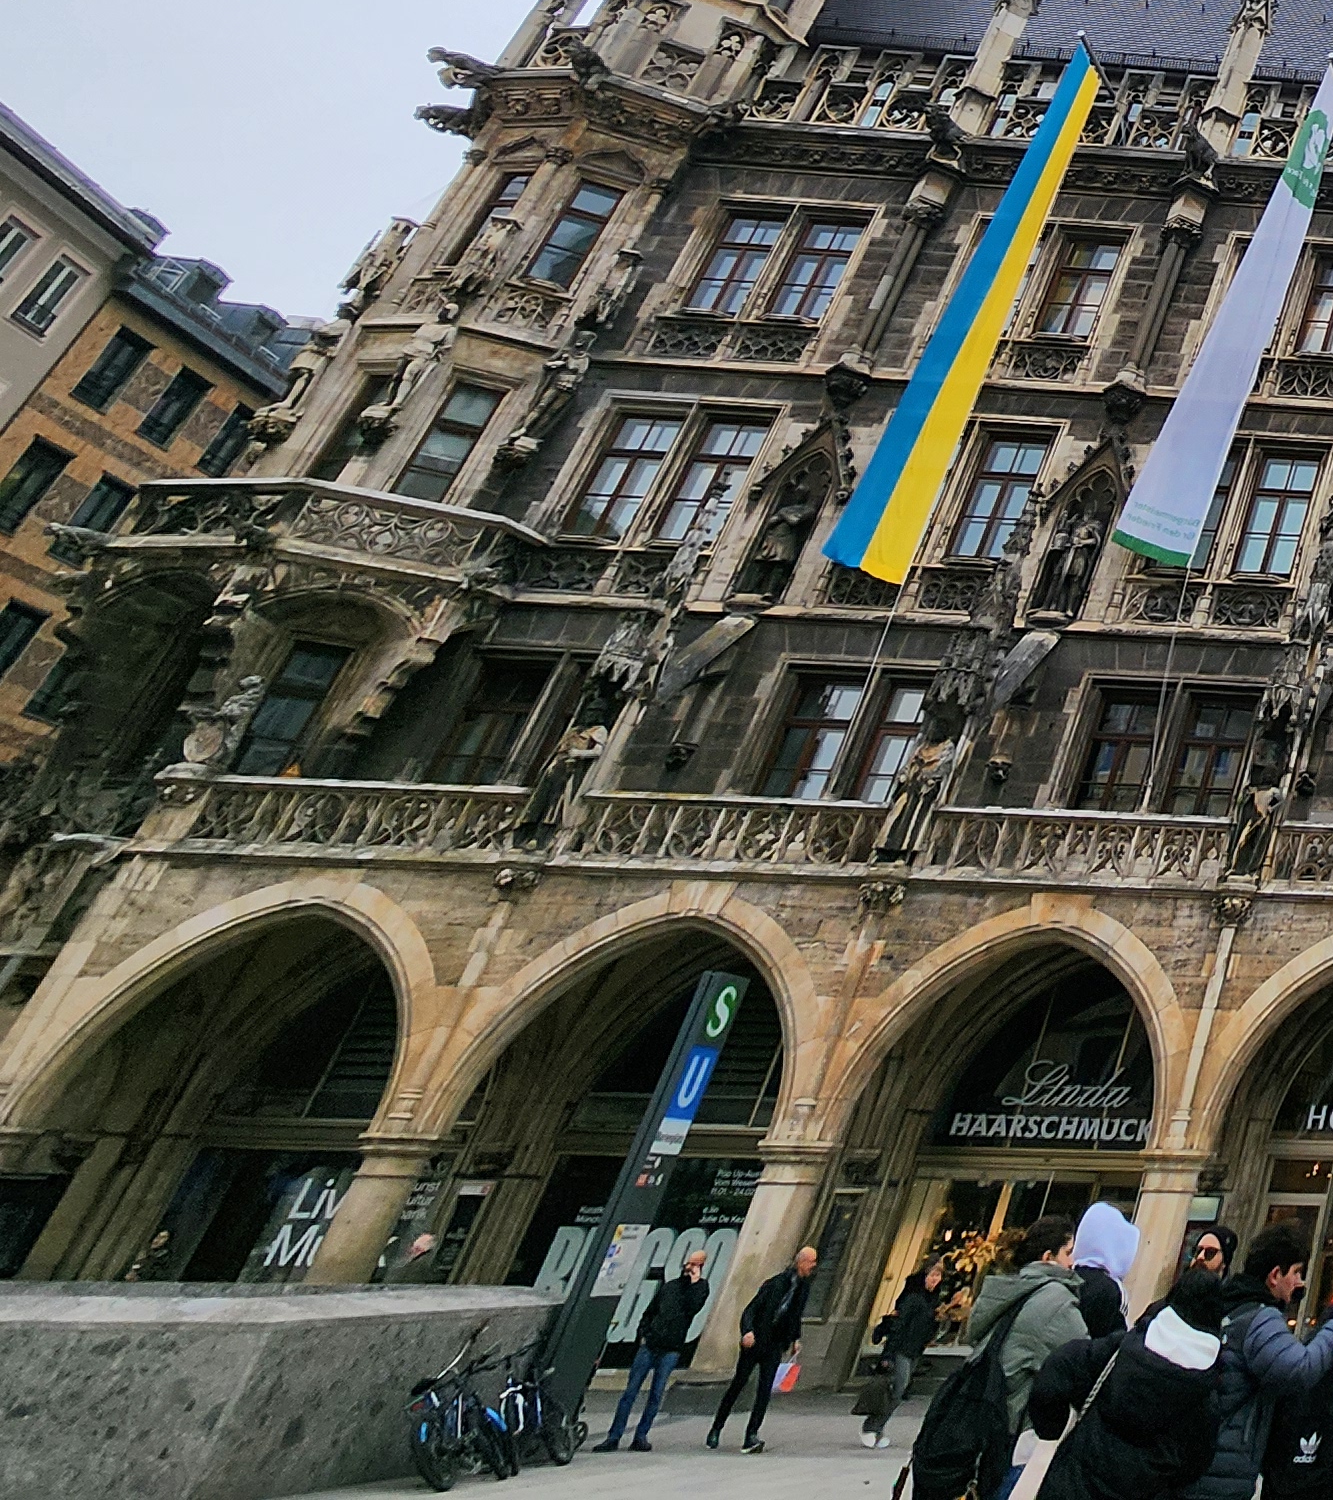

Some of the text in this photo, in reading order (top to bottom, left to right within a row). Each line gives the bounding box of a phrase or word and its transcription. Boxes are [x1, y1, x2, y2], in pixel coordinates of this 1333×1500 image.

[706, 985, 738, 1038] S
[677, 1053, 711, 1109] U
[1001, 1059, 1132, 1108] Linda
[950, 1111, 1153, 1142] HAARSCHMUCK
[288, 1177, 343, 1220] Liv
[414, 1180, 441, 1192] unst
